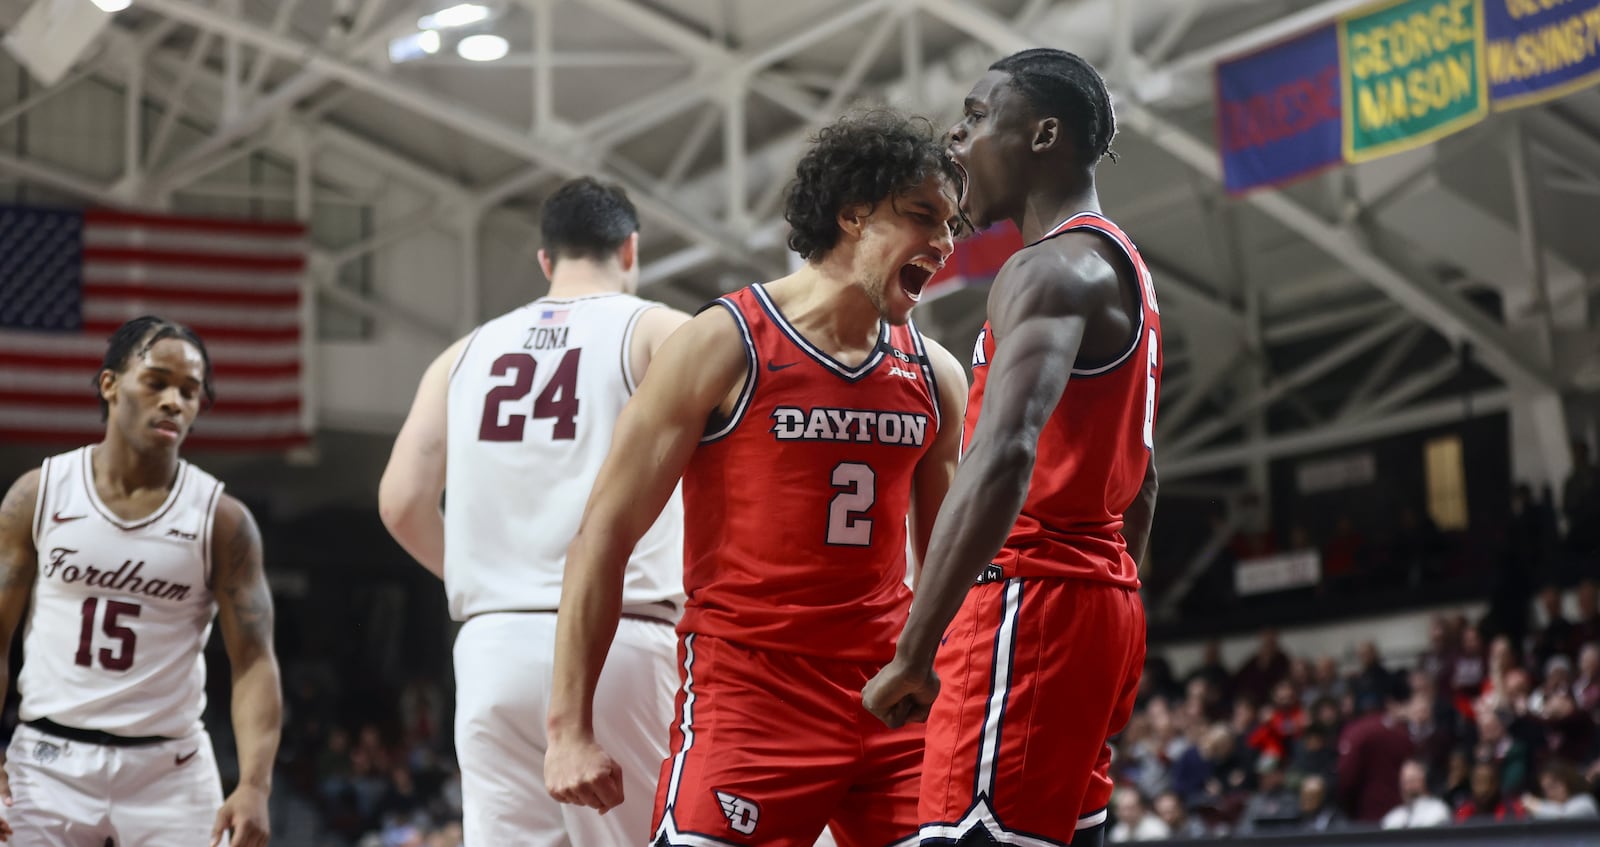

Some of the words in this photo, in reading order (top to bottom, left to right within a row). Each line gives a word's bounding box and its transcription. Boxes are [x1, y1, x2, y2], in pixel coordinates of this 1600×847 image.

[1352, 2, 1475, 80] GEORGE
[1358, 52, 1472, 130] MASON
[523, 327, 570, 350] ZONA
[478, 347, 582, 442] 24
[772, 406, 927, 447] DAYTON
[827, 462, 876, 546] 2
[43, 547, 191, 601] Fordham
[75, 596, 141, 671] 15
